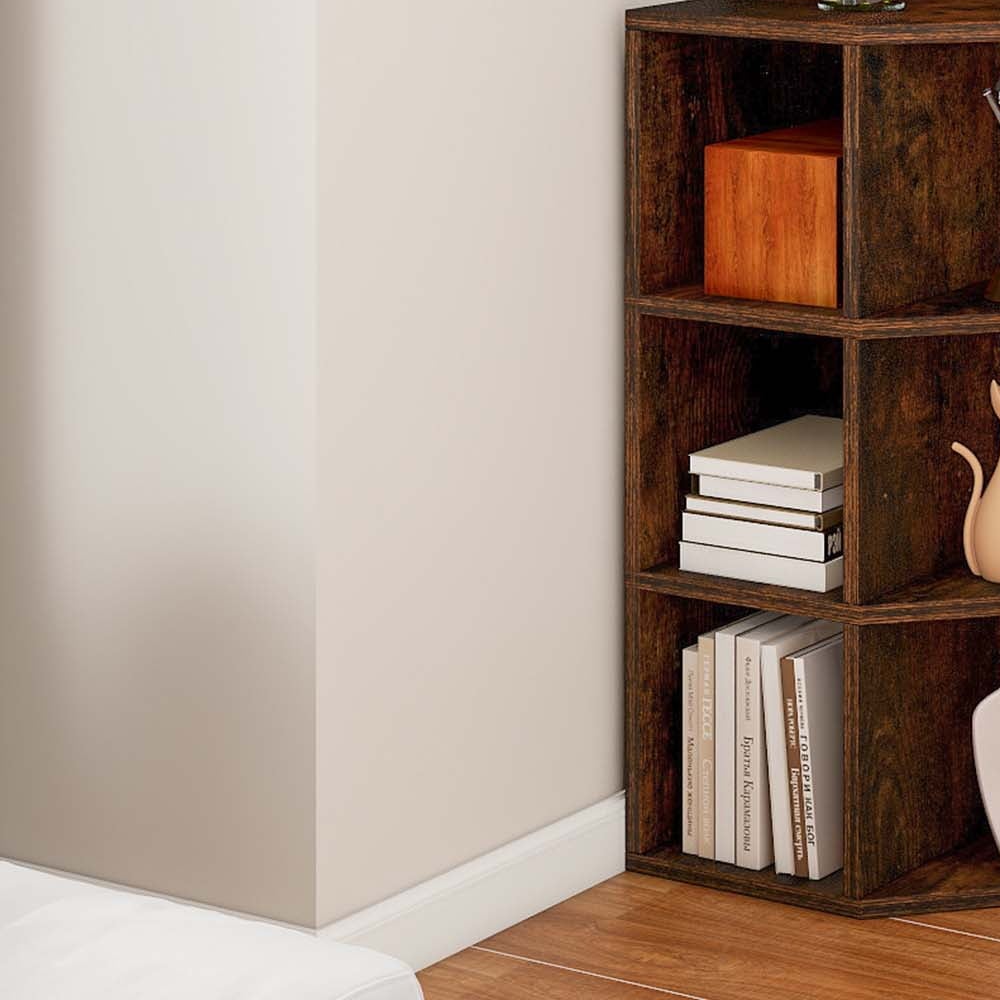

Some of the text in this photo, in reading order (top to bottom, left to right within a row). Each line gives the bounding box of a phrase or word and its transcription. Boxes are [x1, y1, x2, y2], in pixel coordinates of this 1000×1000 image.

[799, 734, 812, 792] ГОВОРИ
[741, 736, 754, 852] Братья Карамазовы
[790, 767, 805, 860] Бархатная смерть
[804, 796, 813, 820] КАК
[807, 824, 816, 847] БОГ
